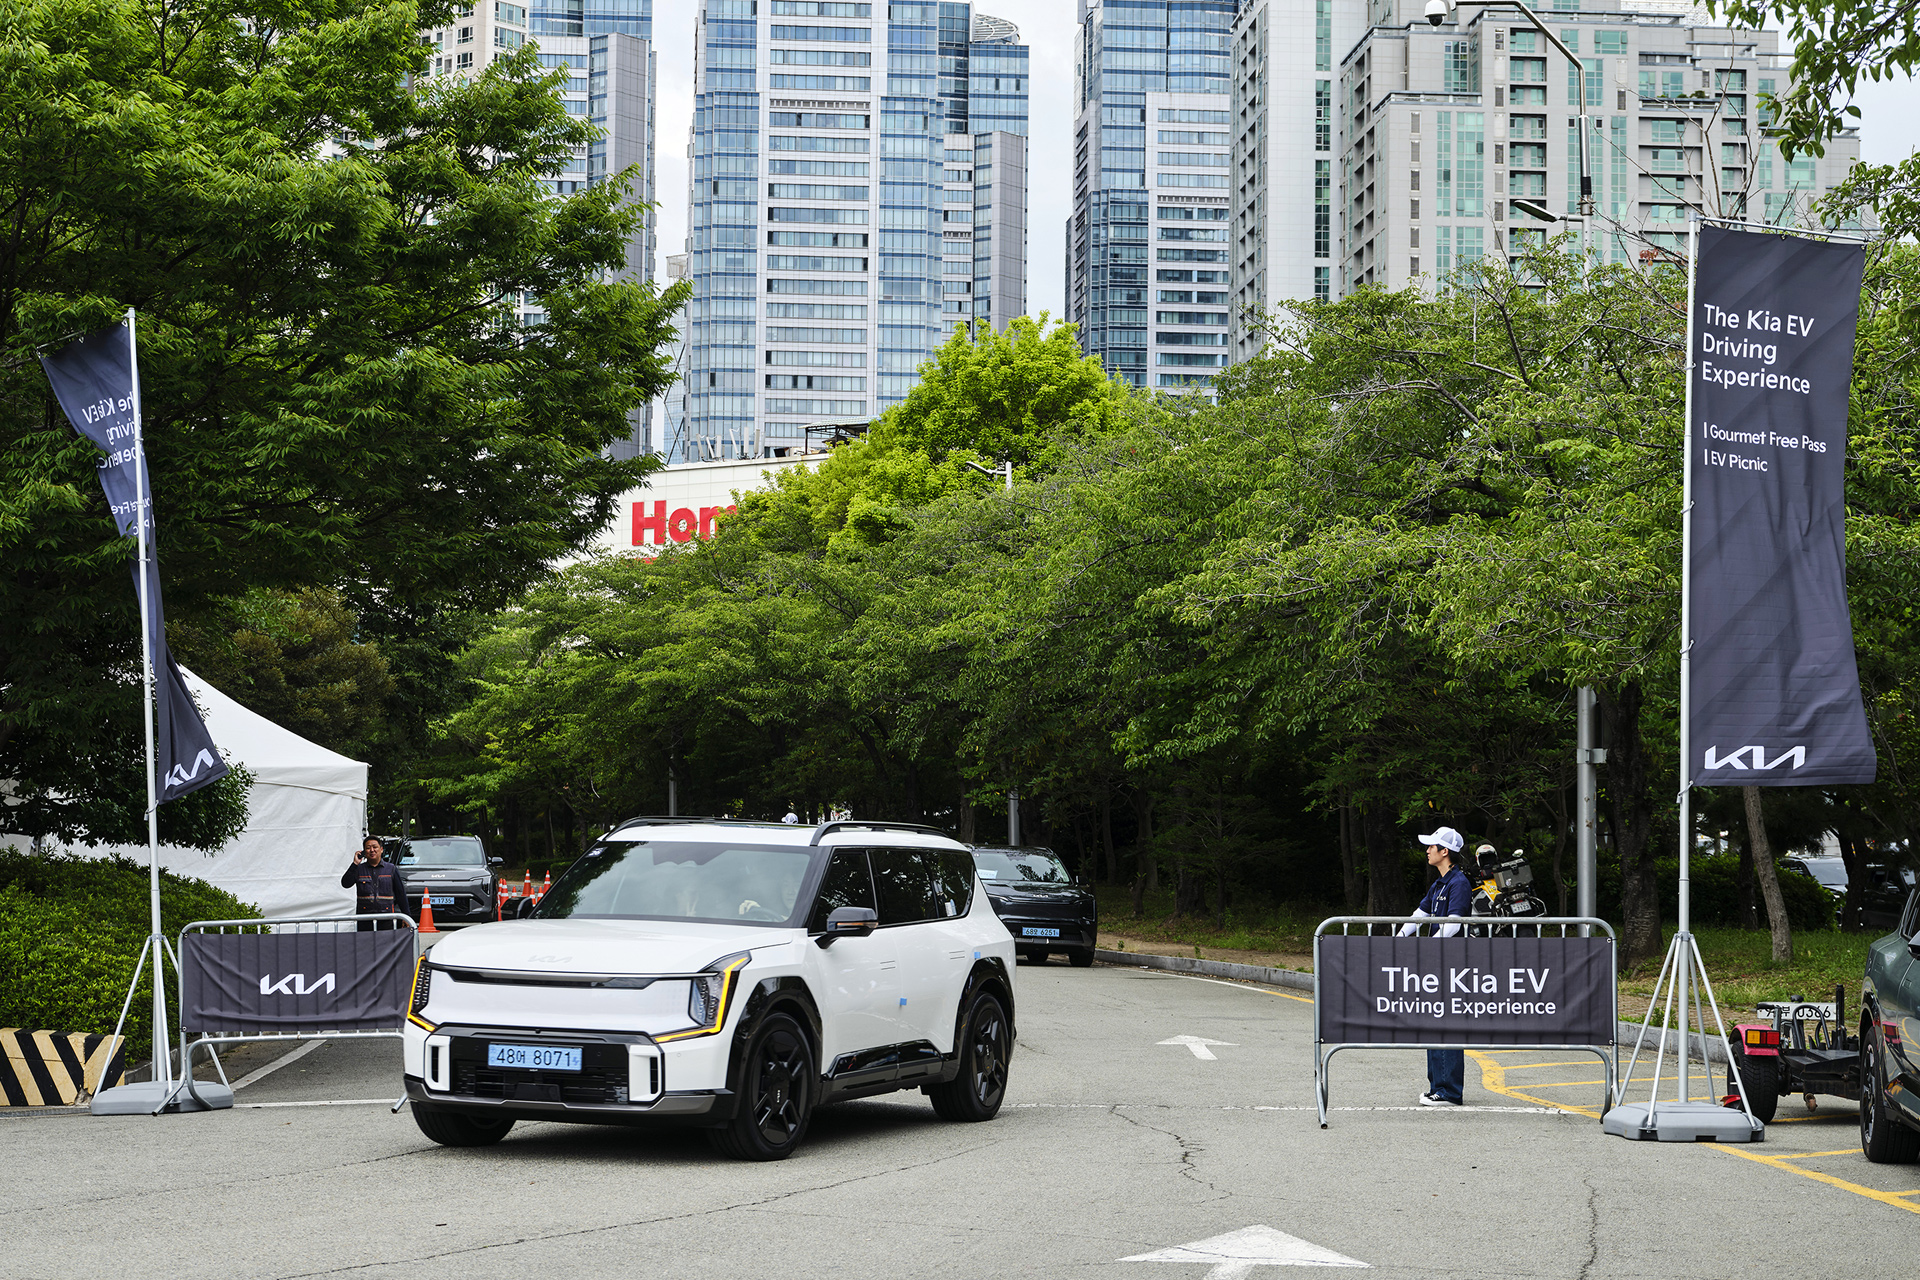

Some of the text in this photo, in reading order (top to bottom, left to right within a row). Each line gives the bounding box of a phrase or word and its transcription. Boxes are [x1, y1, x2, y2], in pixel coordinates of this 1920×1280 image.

[1703, 303, 1815, 337] The Kia EV
[1702, 332, 1777, 365] Driving
[1702, 360, 1811, 395] Experience
[1709, 424, 1827, 453] Gourmet Free Pass
[1711, 450, 1768, 472] EV Picnic
[1704, 745, 1806, 771] KIA
[259, 972, 336, 995] KIA
[1381, 966, 1550, 994] The Kia EV
[1376, 996, 1556, 1018] Driving Experience
[496, 1048, 571, 1067] 48어 8071
